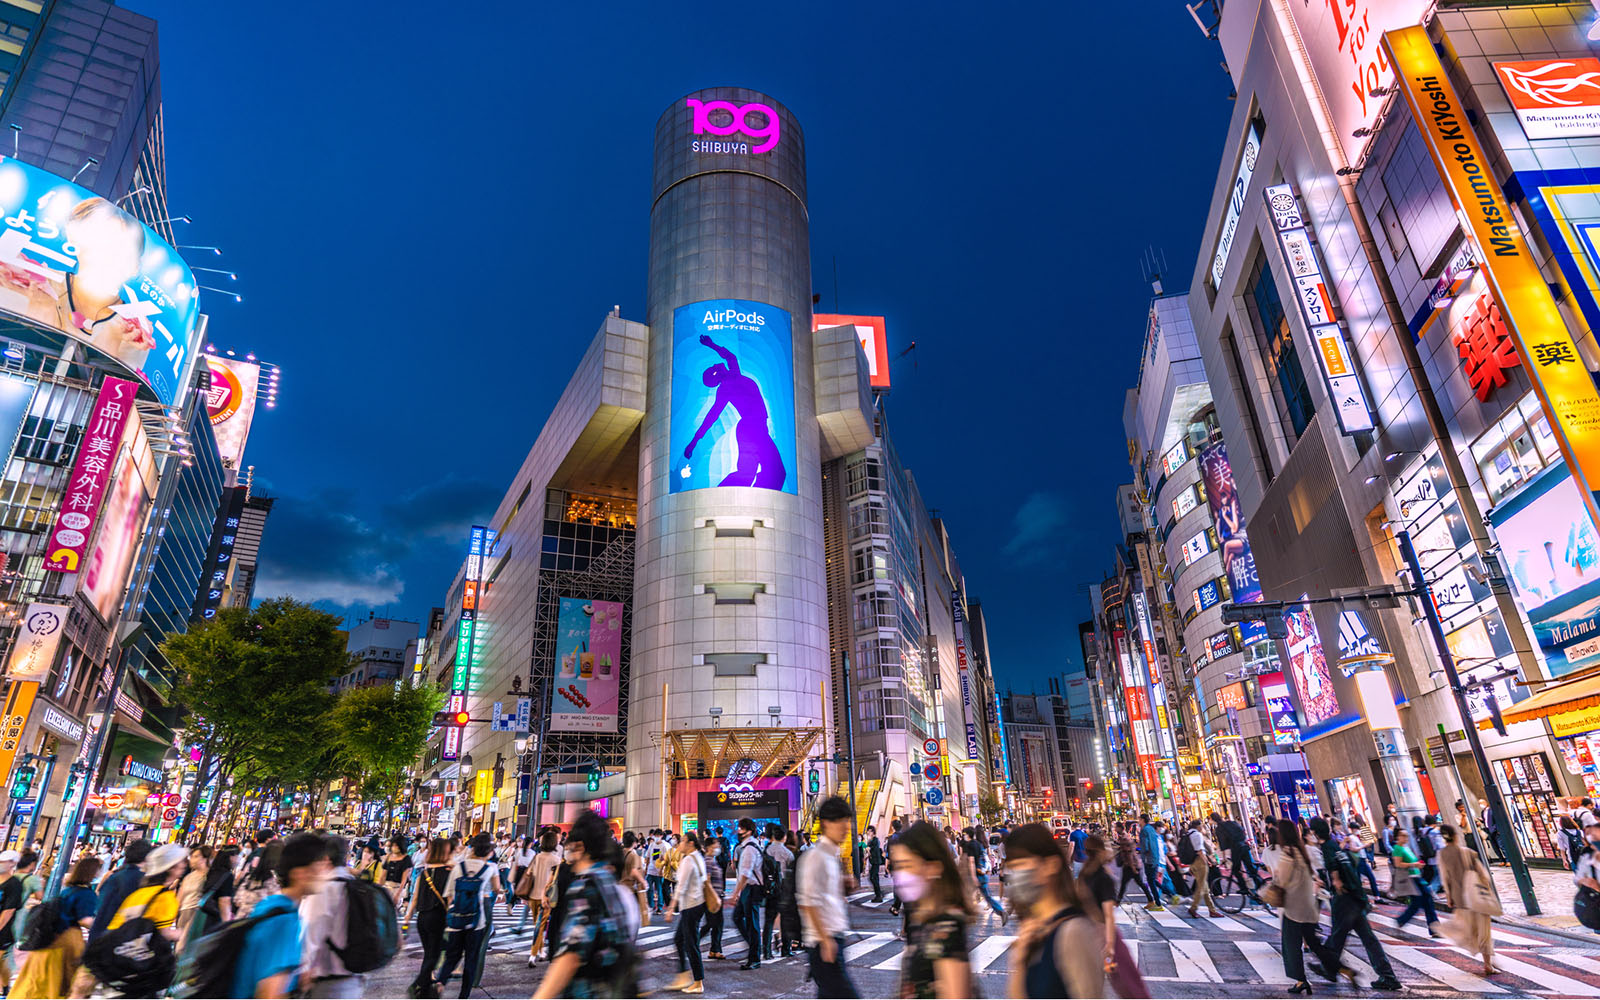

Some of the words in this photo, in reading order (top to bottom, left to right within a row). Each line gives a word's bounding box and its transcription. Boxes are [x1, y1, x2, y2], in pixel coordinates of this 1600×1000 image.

[1350, 8, 1370, 64] for
[686, 99, 780, 154] 109
[692, 142, 747, 154] SHIBUYA
[1232, 177, 1245, 217] UP
[1454, 142, 1519, 257] Matsumoto
[1275, 210, 1298, 218] Darts
[1277, 215, 1301, 228] UP
[1304, 287, 1322, 322] スシロー
[702, 309, 766, 326] AirPods
[1532, 341, 1576, 367] 薬
[1333, 380, 1340, 388] 4
[69, 401, 123, 513] 品川美容外科
[1213, 459, 1232, 492] 美
[1437, 584, 1466, 606] スシロー
[952, 598, 962, 623] LABI
[958, 646, 968, 670] LABI
[1213, 645, 1232, 660] BAGUS
[962, 675, 971, 706] SHIBUYA
[926, 742, 937, 751] 30
[967, 734, 977, 759] LABI
[130, 761, 145, 778] TOHO
[143, 765, 163, 783] CINEMAS
